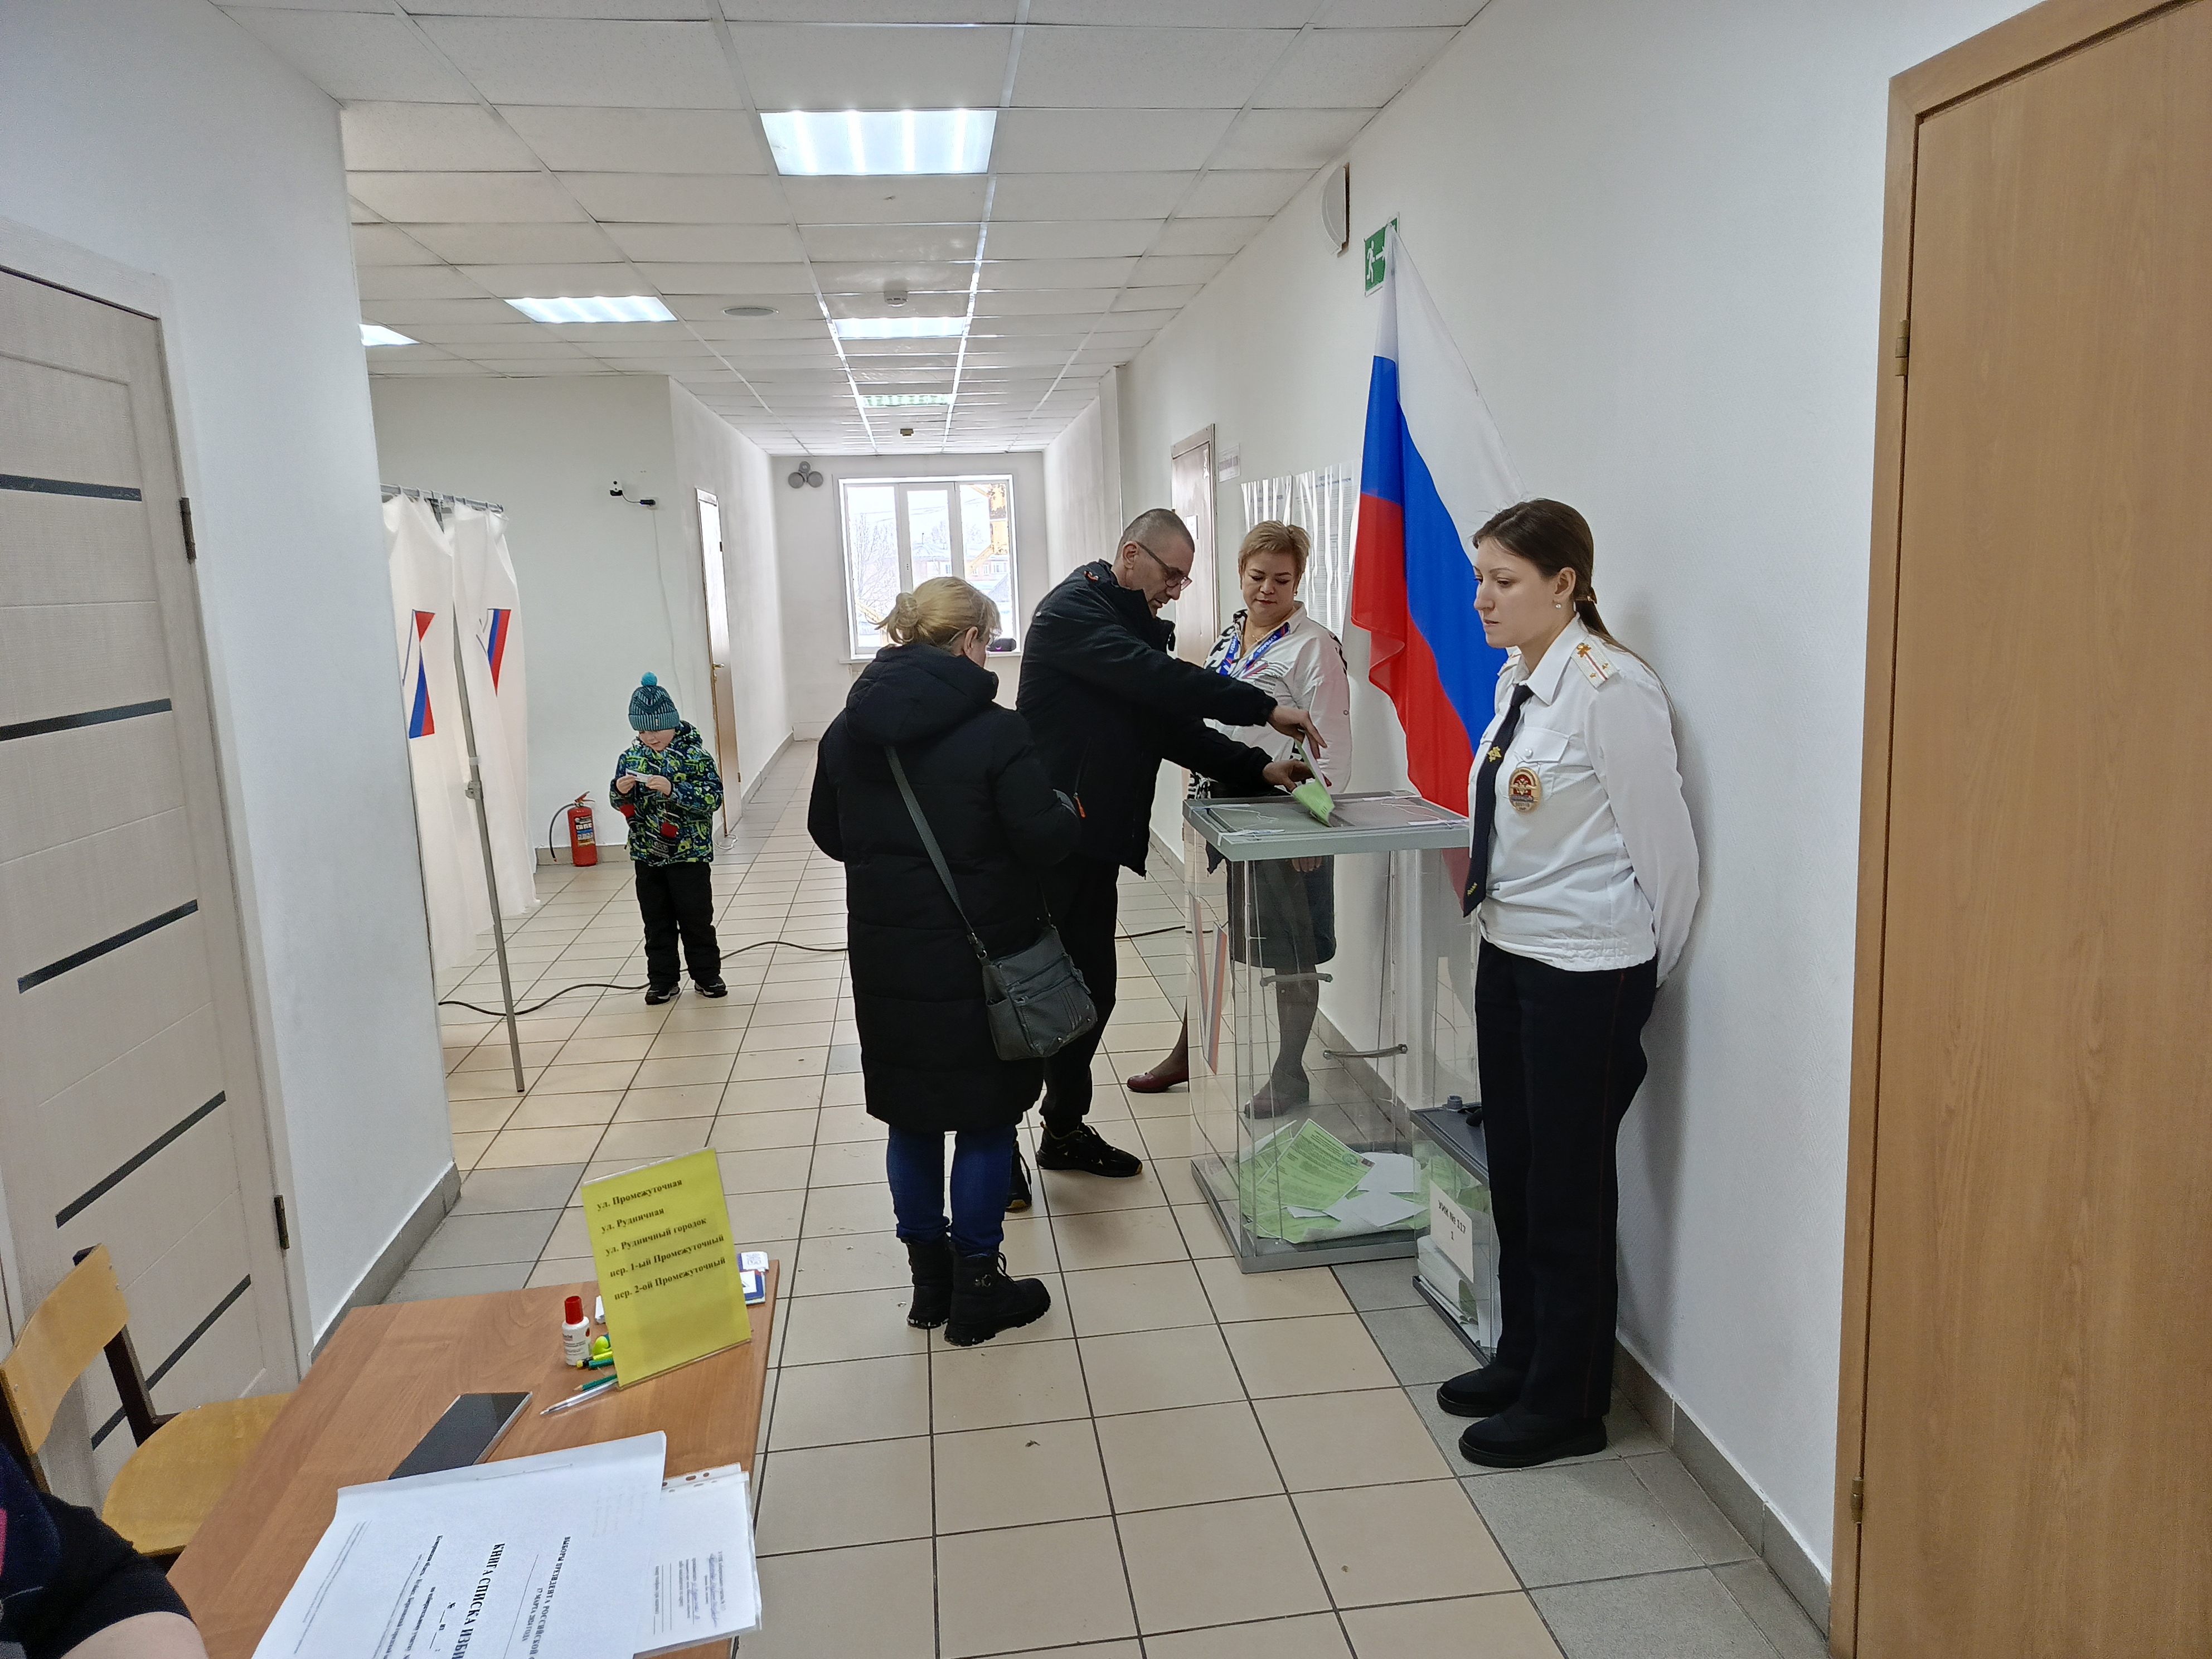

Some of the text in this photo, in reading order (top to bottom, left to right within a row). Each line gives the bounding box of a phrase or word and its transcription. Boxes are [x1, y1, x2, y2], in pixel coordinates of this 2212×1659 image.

[596, 1180, 682, 1212] ул. Промежуточная
[601, 1207, 664, 1234] ул. Рудничная
[1438, 1200, 1466, 1234] УИК № 117
[605, 1217, 707, 1257] ул. Рудничный городок
[1451, 1230, 1454, 1241] 1
[610, 1234, 724, 1277] пер. 1-ый Промежуточный
[614, 1257, 726, 1300] пер. 2-ой Промежуточный
[482, 1542, 506, 1575] КНИГА
[557, 1536, 571, 1561] ВЫБОРЫ
[545, 1562, 563, 1604] ПРЕЗИДЕНТА
[464, 1578, 491, 1626] СПИСКА
[530, 1594, 542, 1614] МАРТА
[522, 1626, 532, 1642] ГОДА
[529, 1605, 550, 1655] РОССИЙСКОЙ
